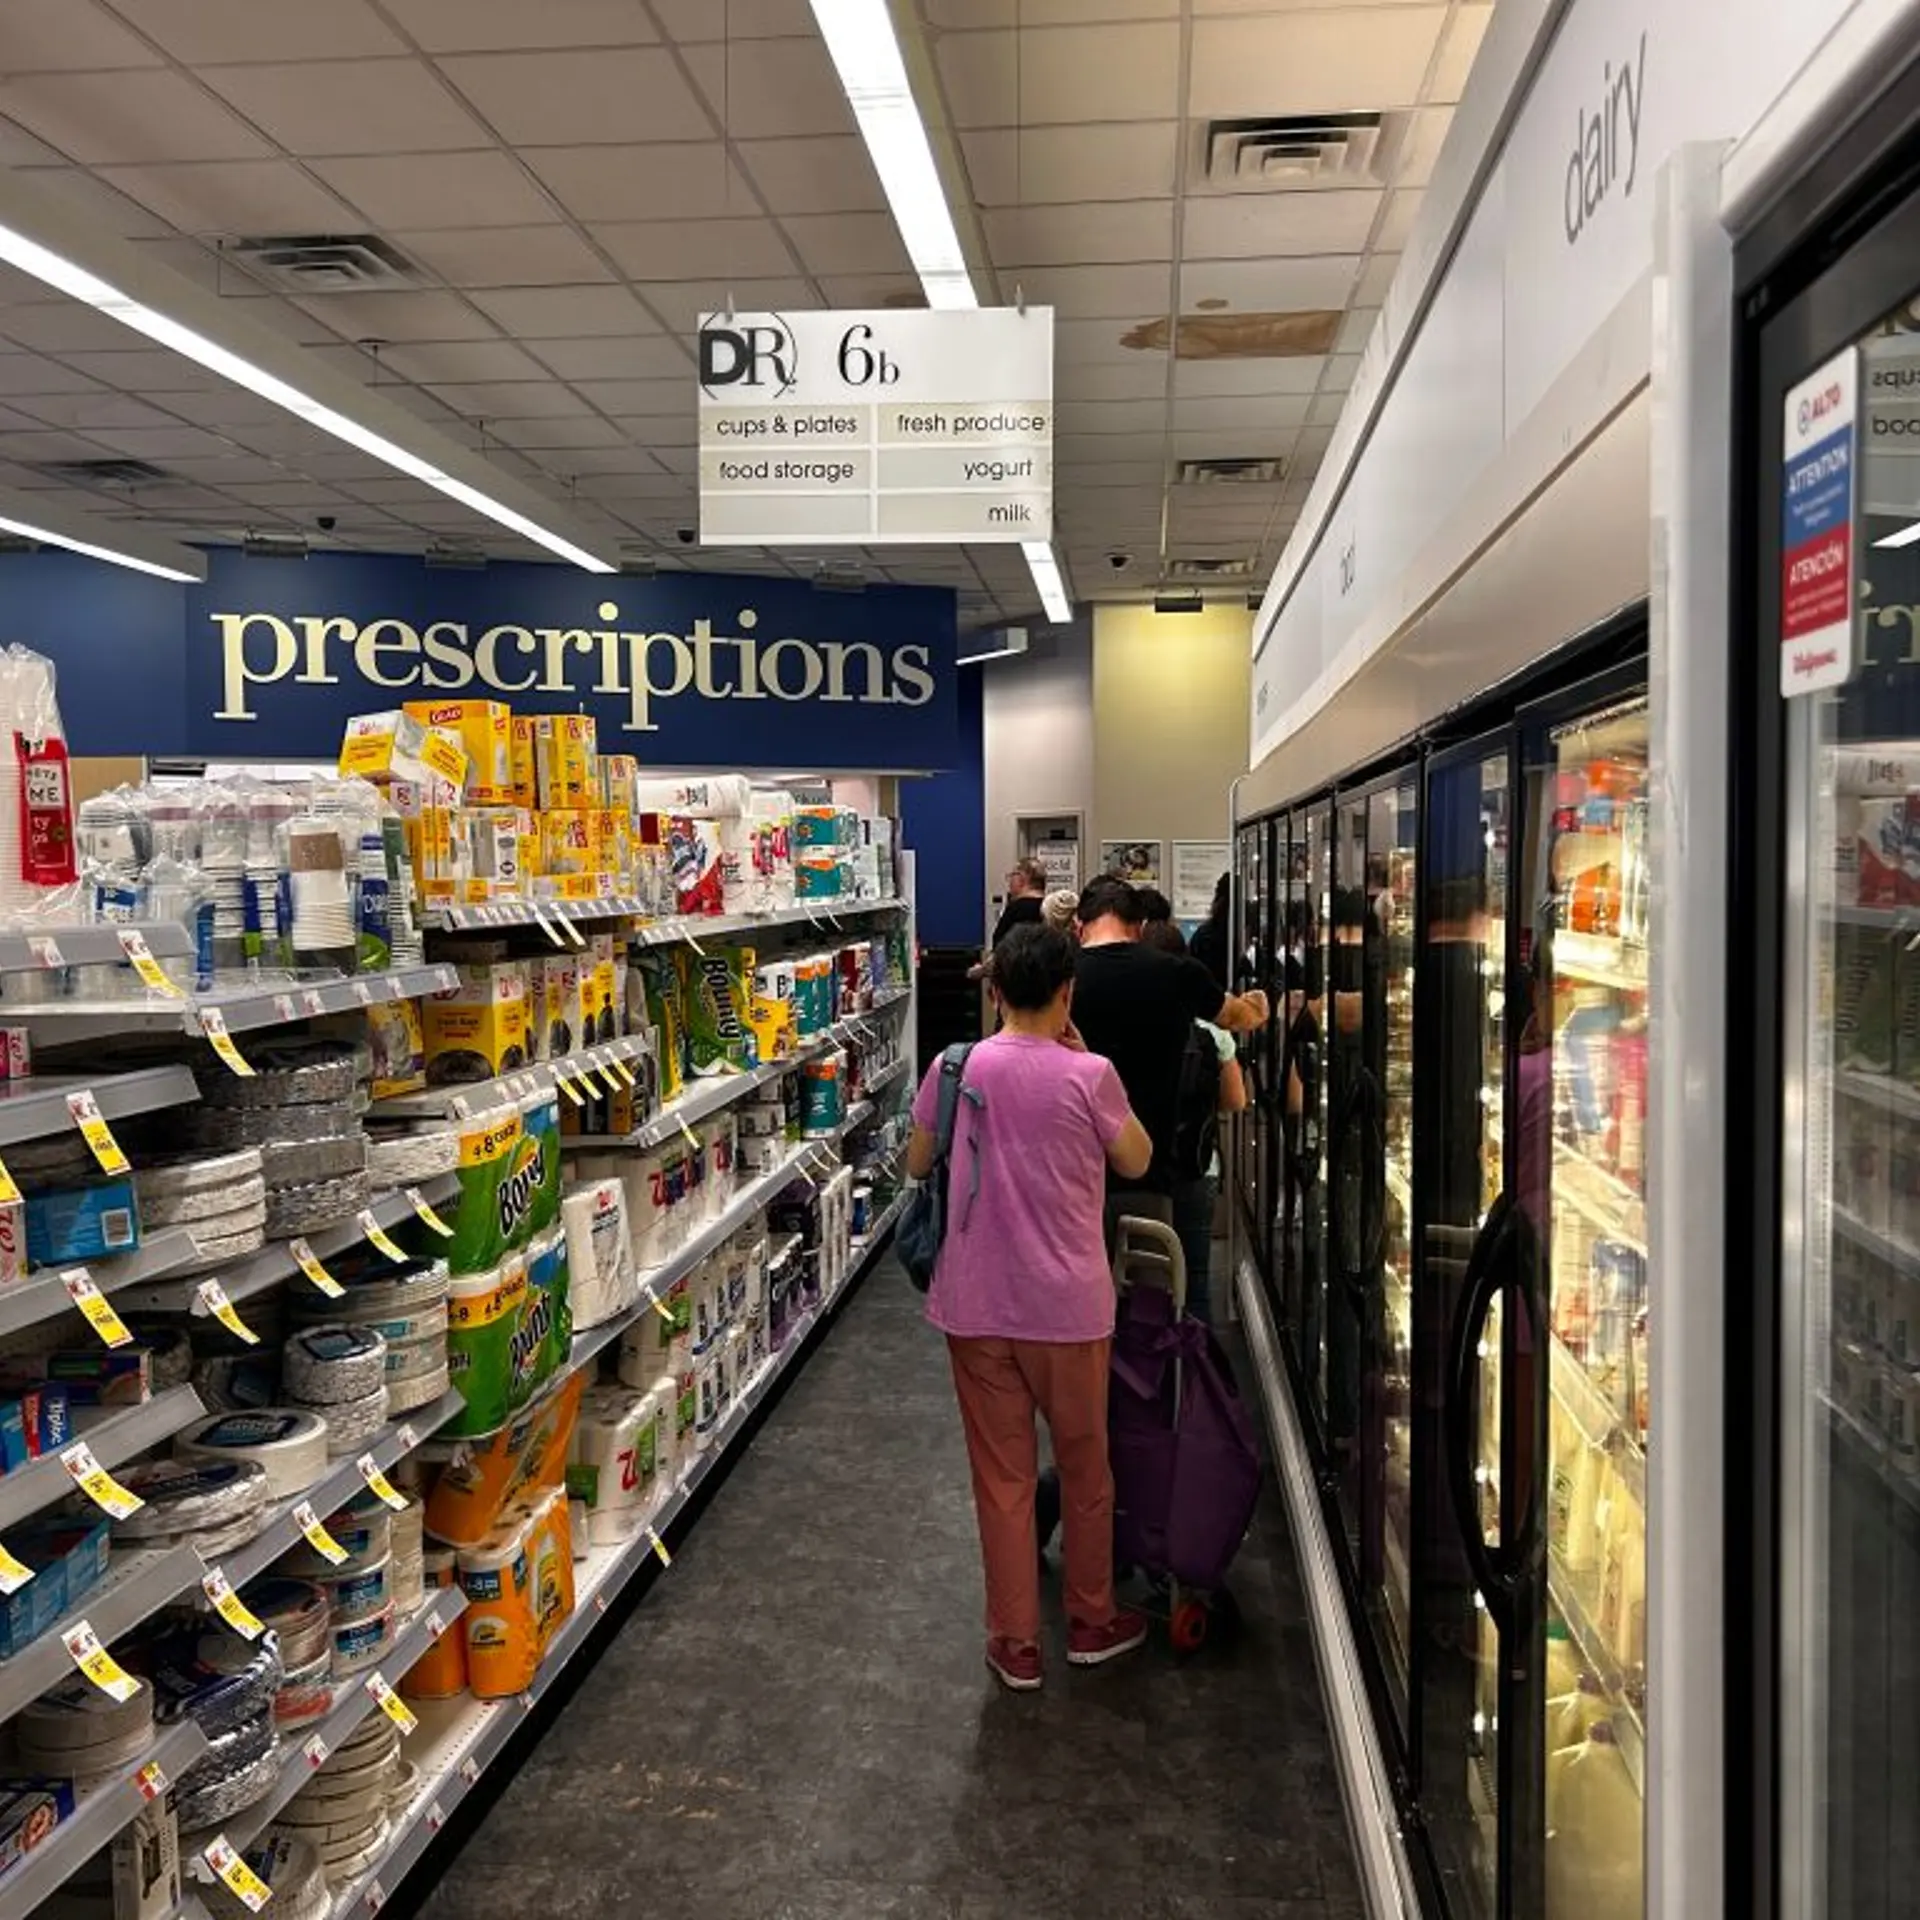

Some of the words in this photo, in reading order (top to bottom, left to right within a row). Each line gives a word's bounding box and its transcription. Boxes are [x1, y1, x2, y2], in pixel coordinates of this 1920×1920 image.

[1564, 28, 1647, 245] dairy
[837, 323, 901, 386] 6b
[716, 416, 767, 438] cups
[772, 415, 789, 433] &
[794, 413, 858, 436] plates
[897, 412, 946, 432] fresh
[952, 411, 1045, 435] produce
[719, 460, 769, 480] food
[773, 461, 855, 483] storage
[962, 458, 1034, 481] yogurt
[1788, 444, 1848, 494] ATTENTION
[987, 502, 1032, 522] milk
[209, 601, 938, 731] prescriptions
[700, 958, 741, 1039] Bounty
